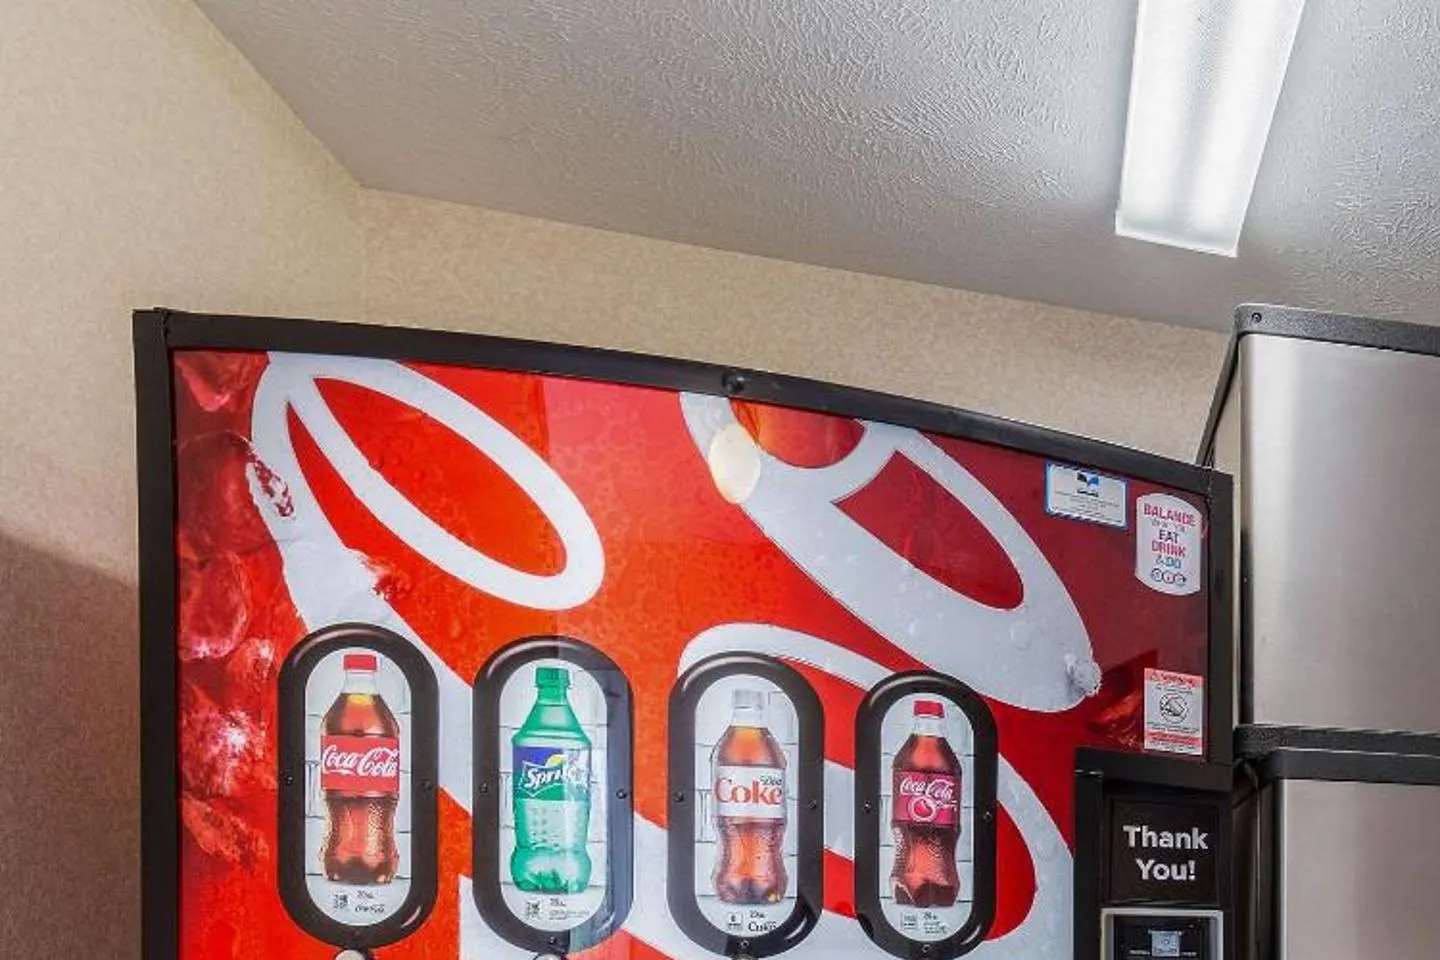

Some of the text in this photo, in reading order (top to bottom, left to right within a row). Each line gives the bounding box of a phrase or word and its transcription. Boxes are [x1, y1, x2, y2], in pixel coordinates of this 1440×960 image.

[1159, 529, 1180, 544] EAT
[1151, 541, 1186, 558] DRINK
[322, 744, 399, 778] Coca-Cola
[715, 776, 783, 805] Coke
[901, 775, 955, 799] Coca-Cola
[1123, 824, 1209, 850] Thank
[1135, 858, 1197, 881] You!
